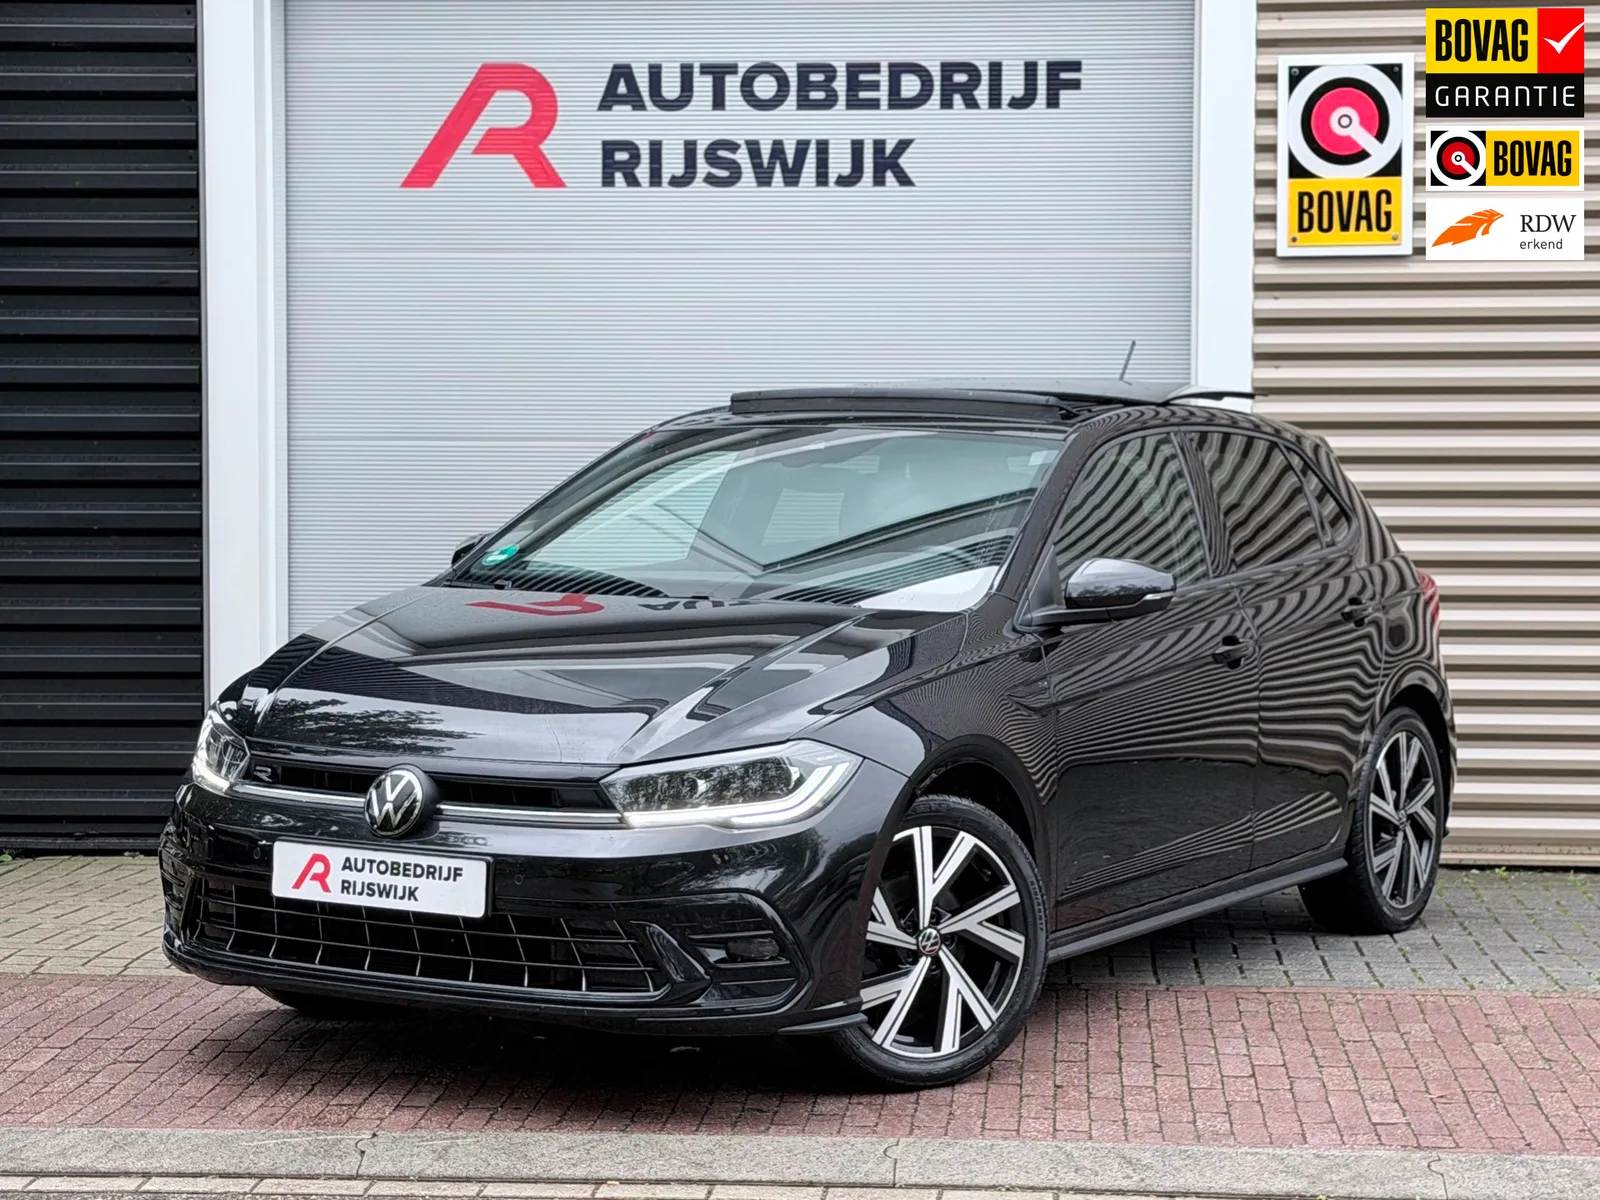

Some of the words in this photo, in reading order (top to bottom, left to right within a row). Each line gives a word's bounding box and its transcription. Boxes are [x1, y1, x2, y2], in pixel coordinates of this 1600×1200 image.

[598, 61, 1082, 111] AUTOBEDRIJF
[601, 139, 915, 187] RIJSWIJK
[1297, 189, 1392, 233] BOVAG
[340, 879, 419, 902] RIJSWIJK
[341, 856, 464, 883] AUTOBEDRIJF
